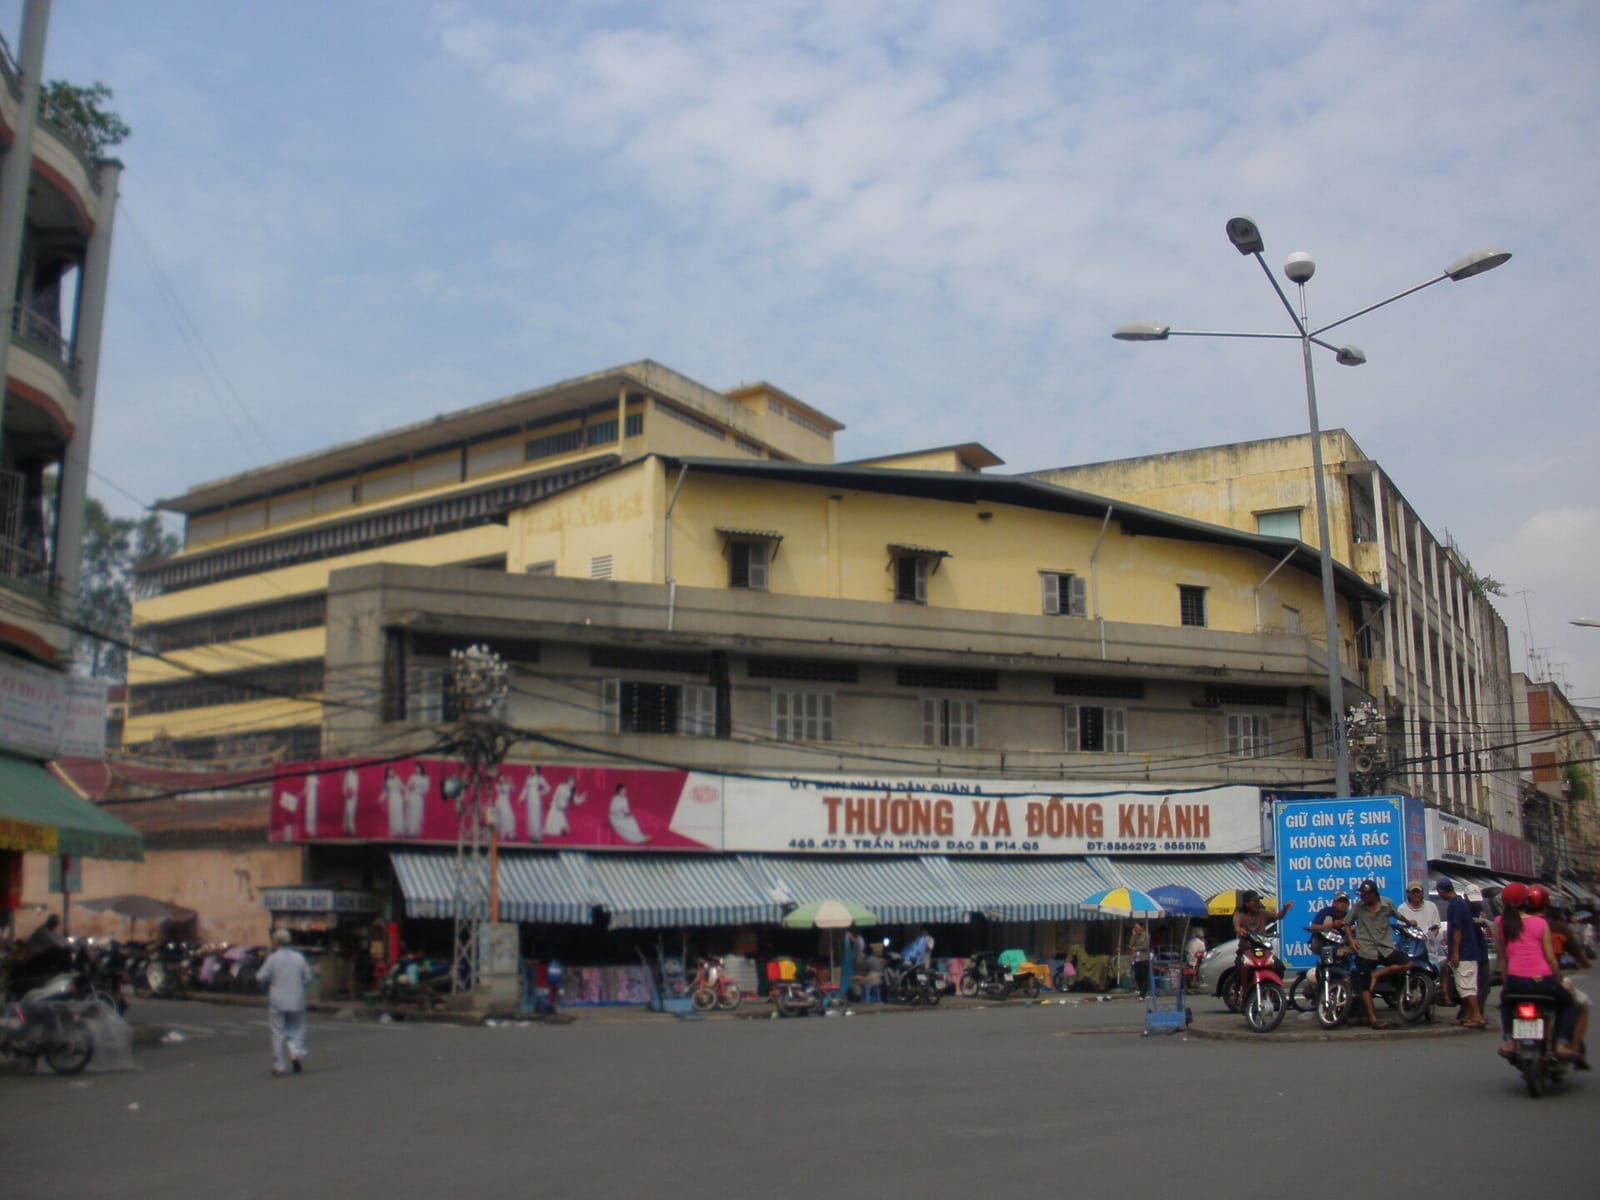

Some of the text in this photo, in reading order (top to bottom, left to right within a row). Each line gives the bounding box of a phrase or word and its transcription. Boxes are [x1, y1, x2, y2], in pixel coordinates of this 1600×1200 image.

[823, 791, 954, 837] THƯƠNG
[1118, 797, 1210, 838] KHÁNH
[1285, 809, 1391, 828] GIỮ GÌN VỆ SINH
[900, 839, 941, 850] HƯNG
[1290, 829, 1389, 849] KHÔNG XẢ RÁC
[1289, 851, 1392, 870] NƠI CÔNG CỘNG
[1296, 875, 1313, 891] LÀ
[1317, 874, 1344, 890] GÓP
[1308, 897, 1334, 912] XÂY
